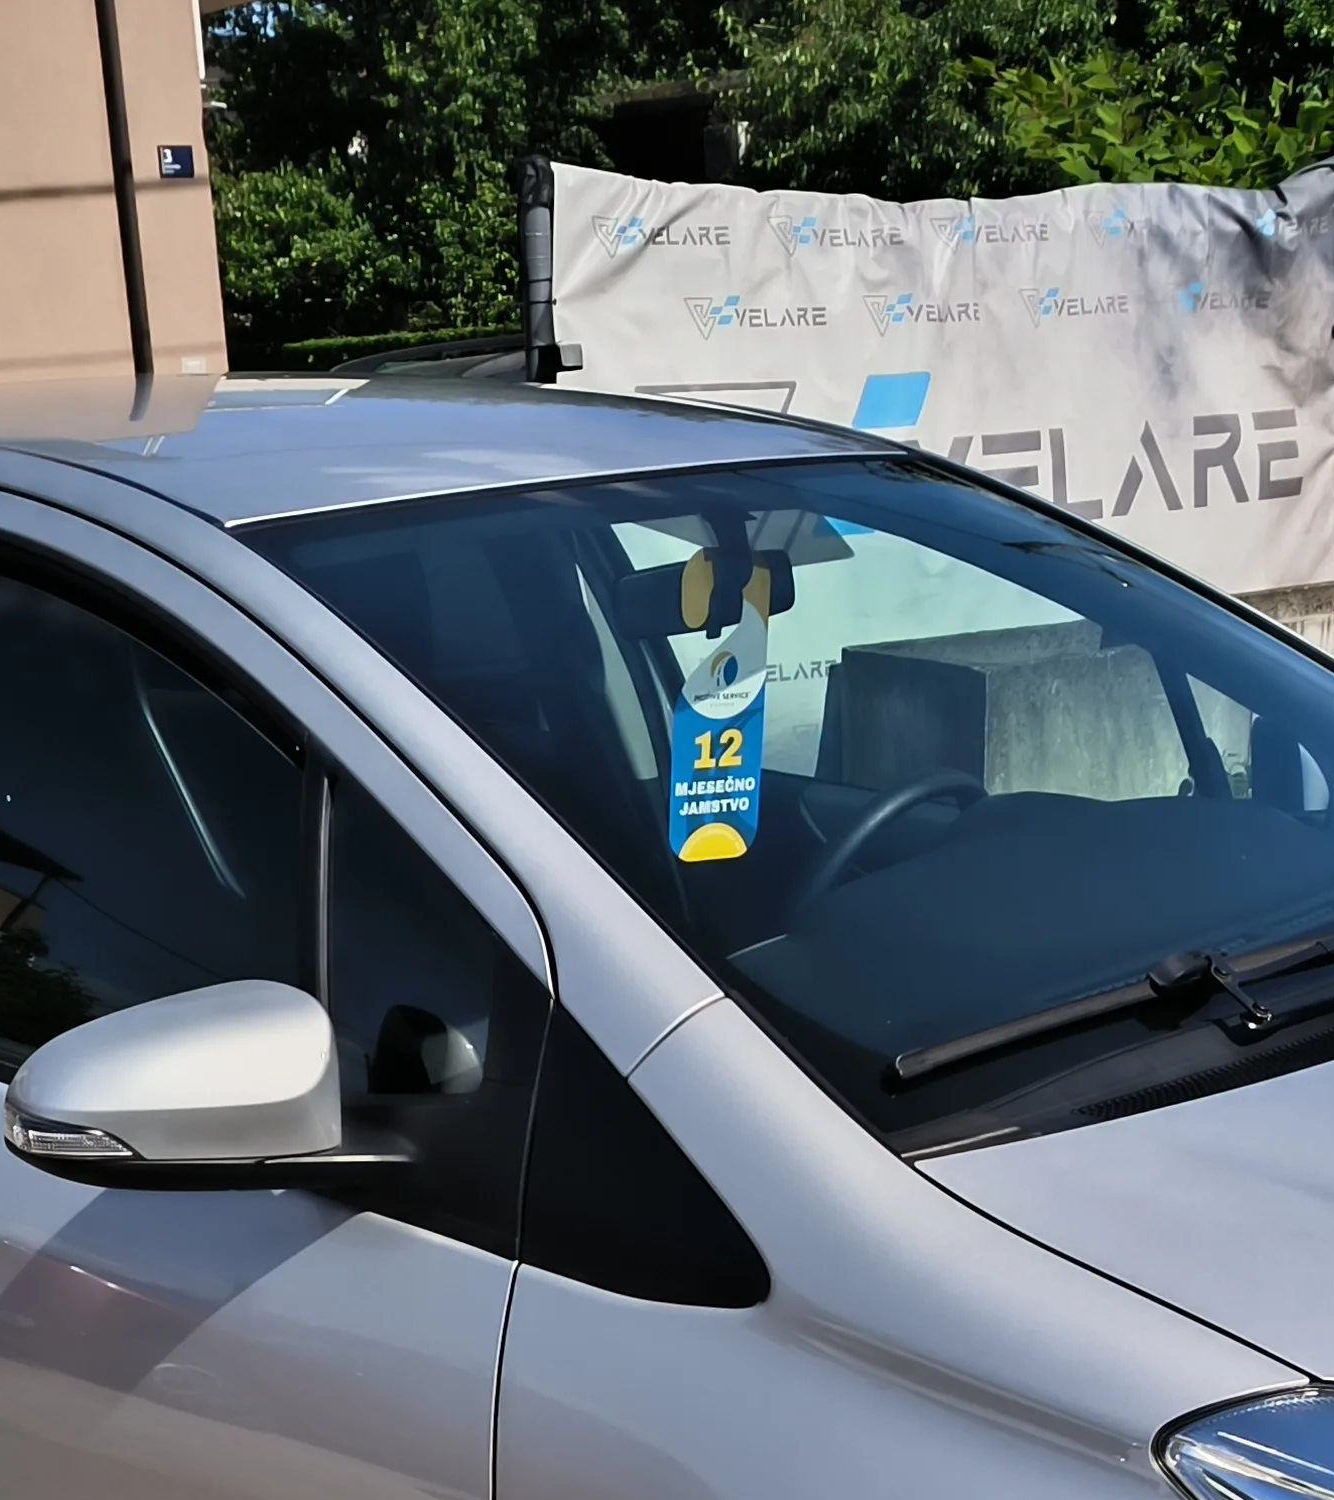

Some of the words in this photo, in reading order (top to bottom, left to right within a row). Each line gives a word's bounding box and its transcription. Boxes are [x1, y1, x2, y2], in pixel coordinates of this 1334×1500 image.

[638, 225, 731, 247] VELARE
[812, 226, 904, 248] VELARE
[734, 305, 827, 329] VELARE
[1053, 294, 1130, 318] VELARE
[693, 728, 744, 770] 12
[674, 775, 756, 798] MJESEČNO
[679, 797, 750, 816] JAMSTVO
